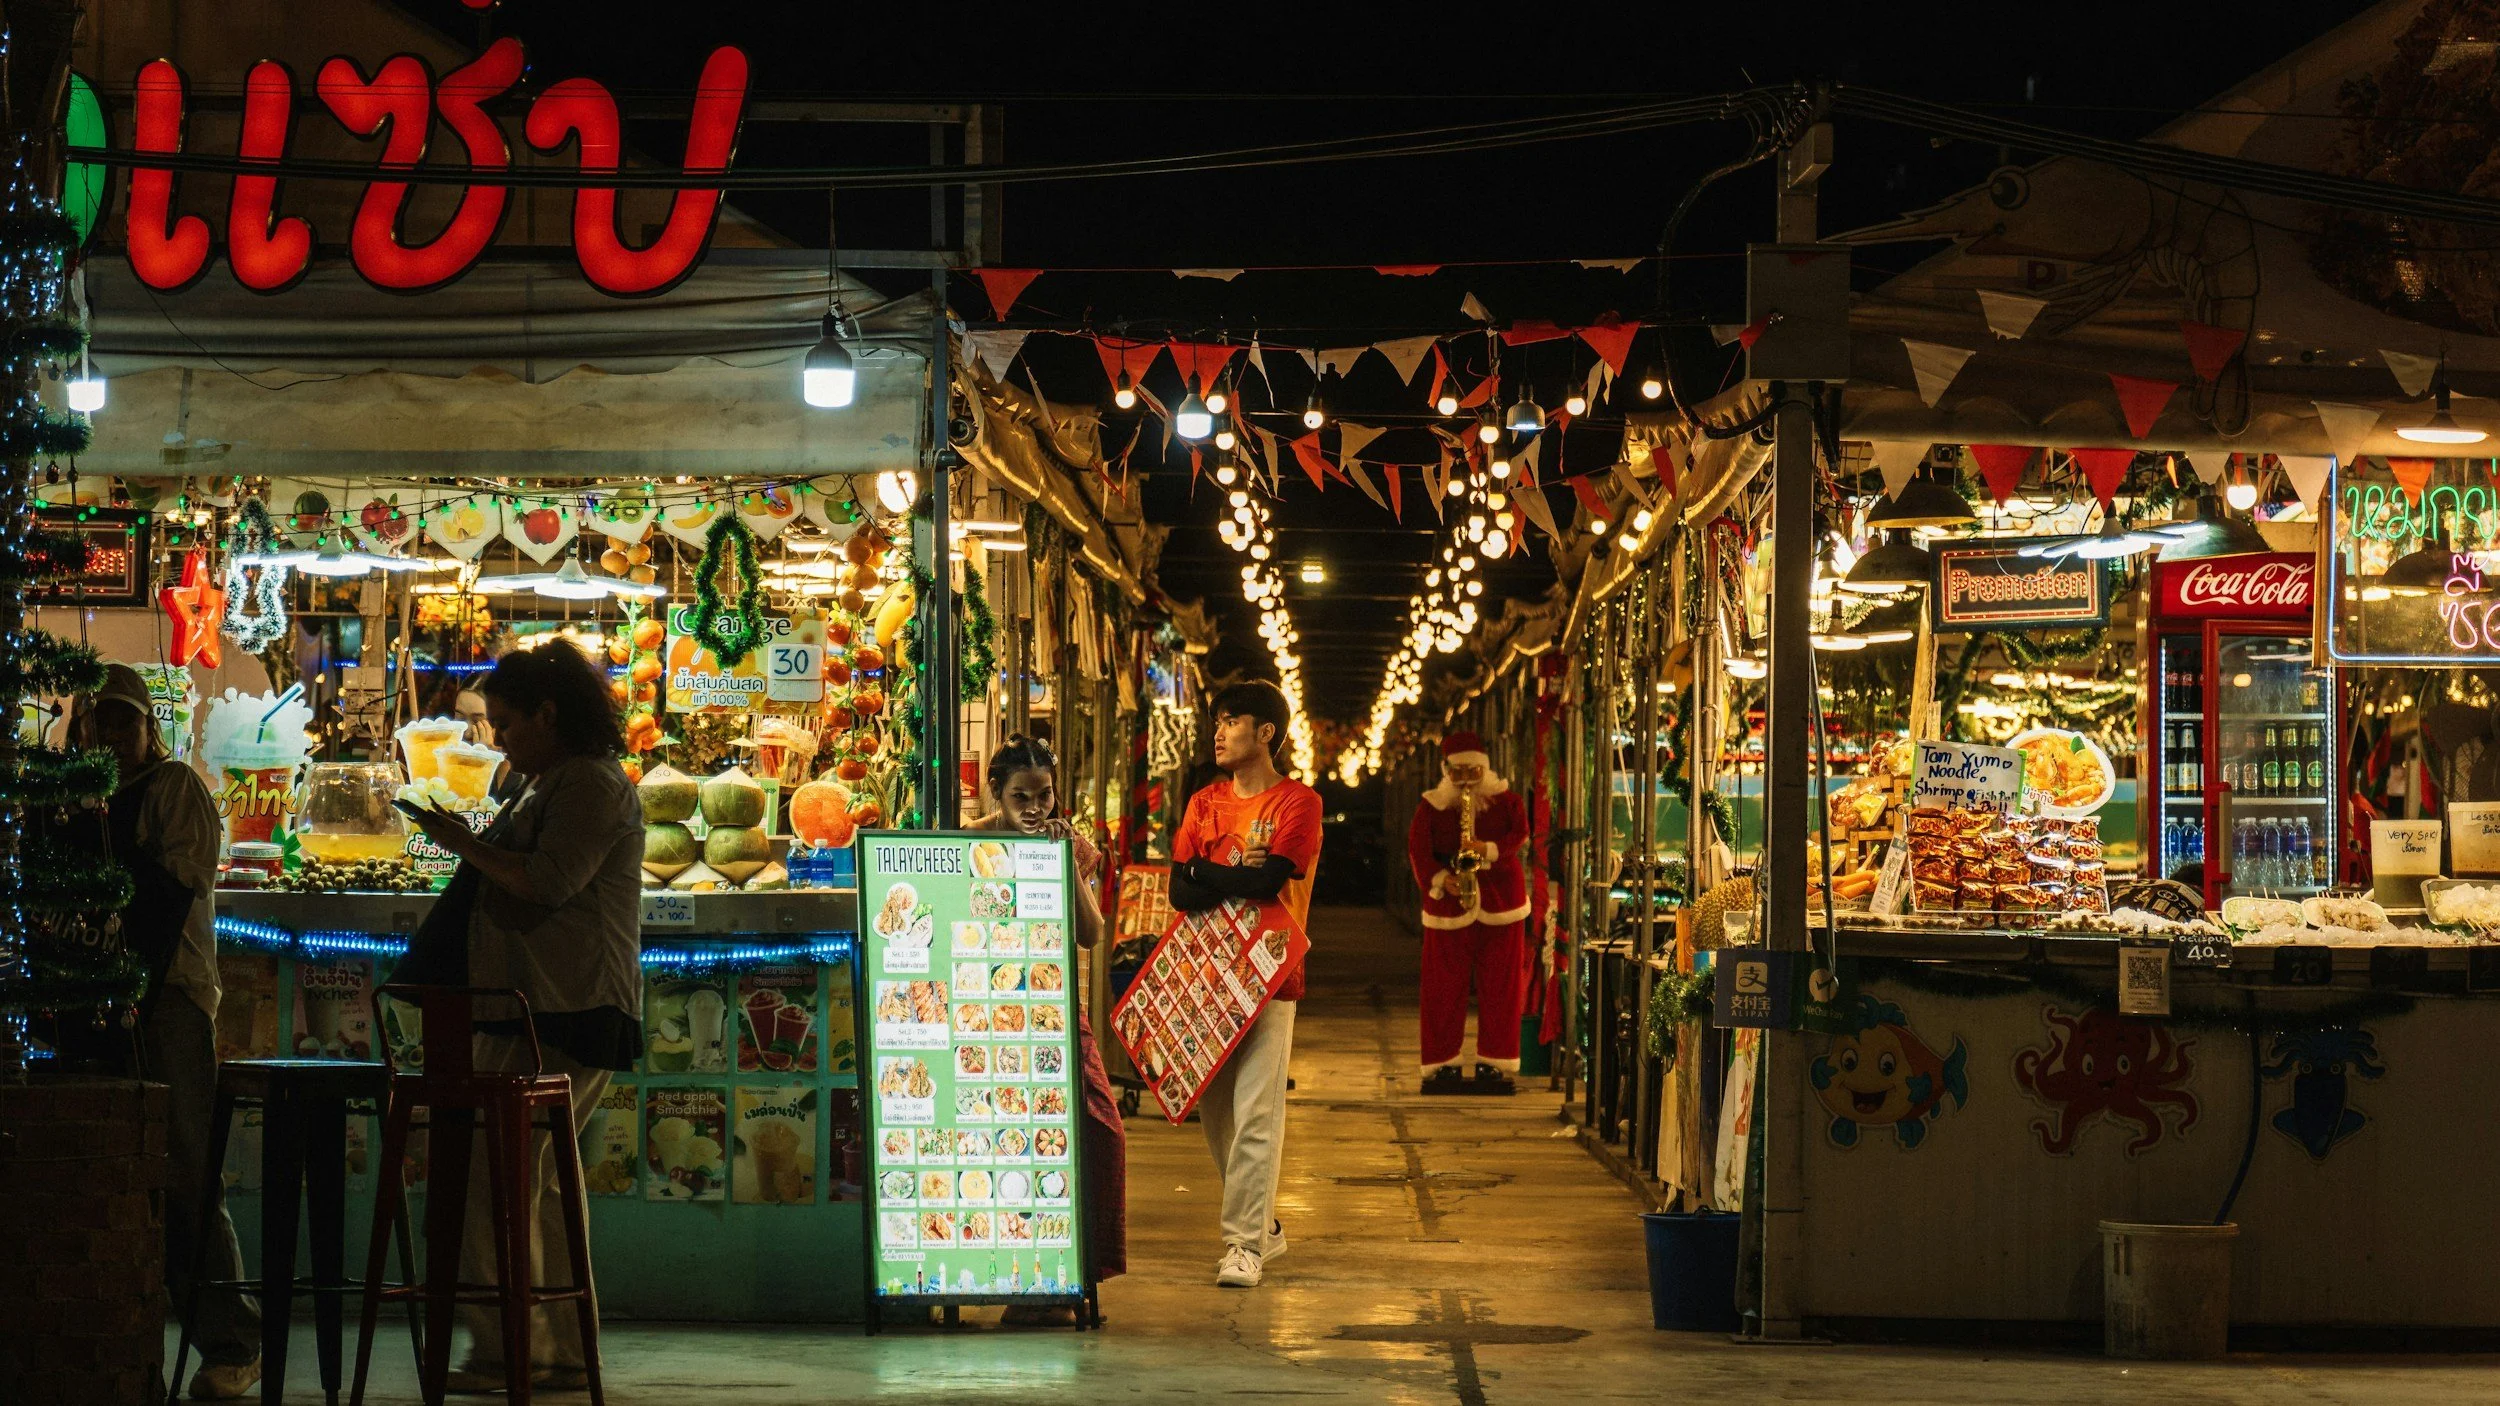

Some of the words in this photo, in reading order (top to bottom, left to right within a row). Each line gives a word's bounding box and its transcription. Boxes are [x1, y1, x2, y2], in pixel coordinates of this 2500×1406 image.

[127, 0, 753, 297] แซบ
[1951, 565, 2090, 603] Promotion
[2179, 562, 2314, 606] Coca-Cola
[773, 648, 811, 677] 30
[675, 669, 765, 692] น้ำส้มคั้นสด
[693, 693, 707, 706] แท้
[712, 694, 748, 706] 100%
[1961, 750, 2001, 769] Yum
[655, 769, 671, 779] 50
[1914, 777, 1965, 800] Shrimp
[2471, 812, 2494, 821] Less
[2387, 829, 2413, 844] Very
[876, 846, 963, 874] TALAYCHEESE
[1032, 863, 1044, 872] 150
[646, 911, 654, 920] 4
[1730, 994, 1771, 1010] 支付宝
[1730, 1009, 1771, 1018] ALIPAY
[658, 1091, 681, 1101] Red
[683, 1091, 717, 1104] apple
[656, 1105, 719, 1116] Smoothie
[745, 1098, 806, 1122] เมล่อนปั่น
